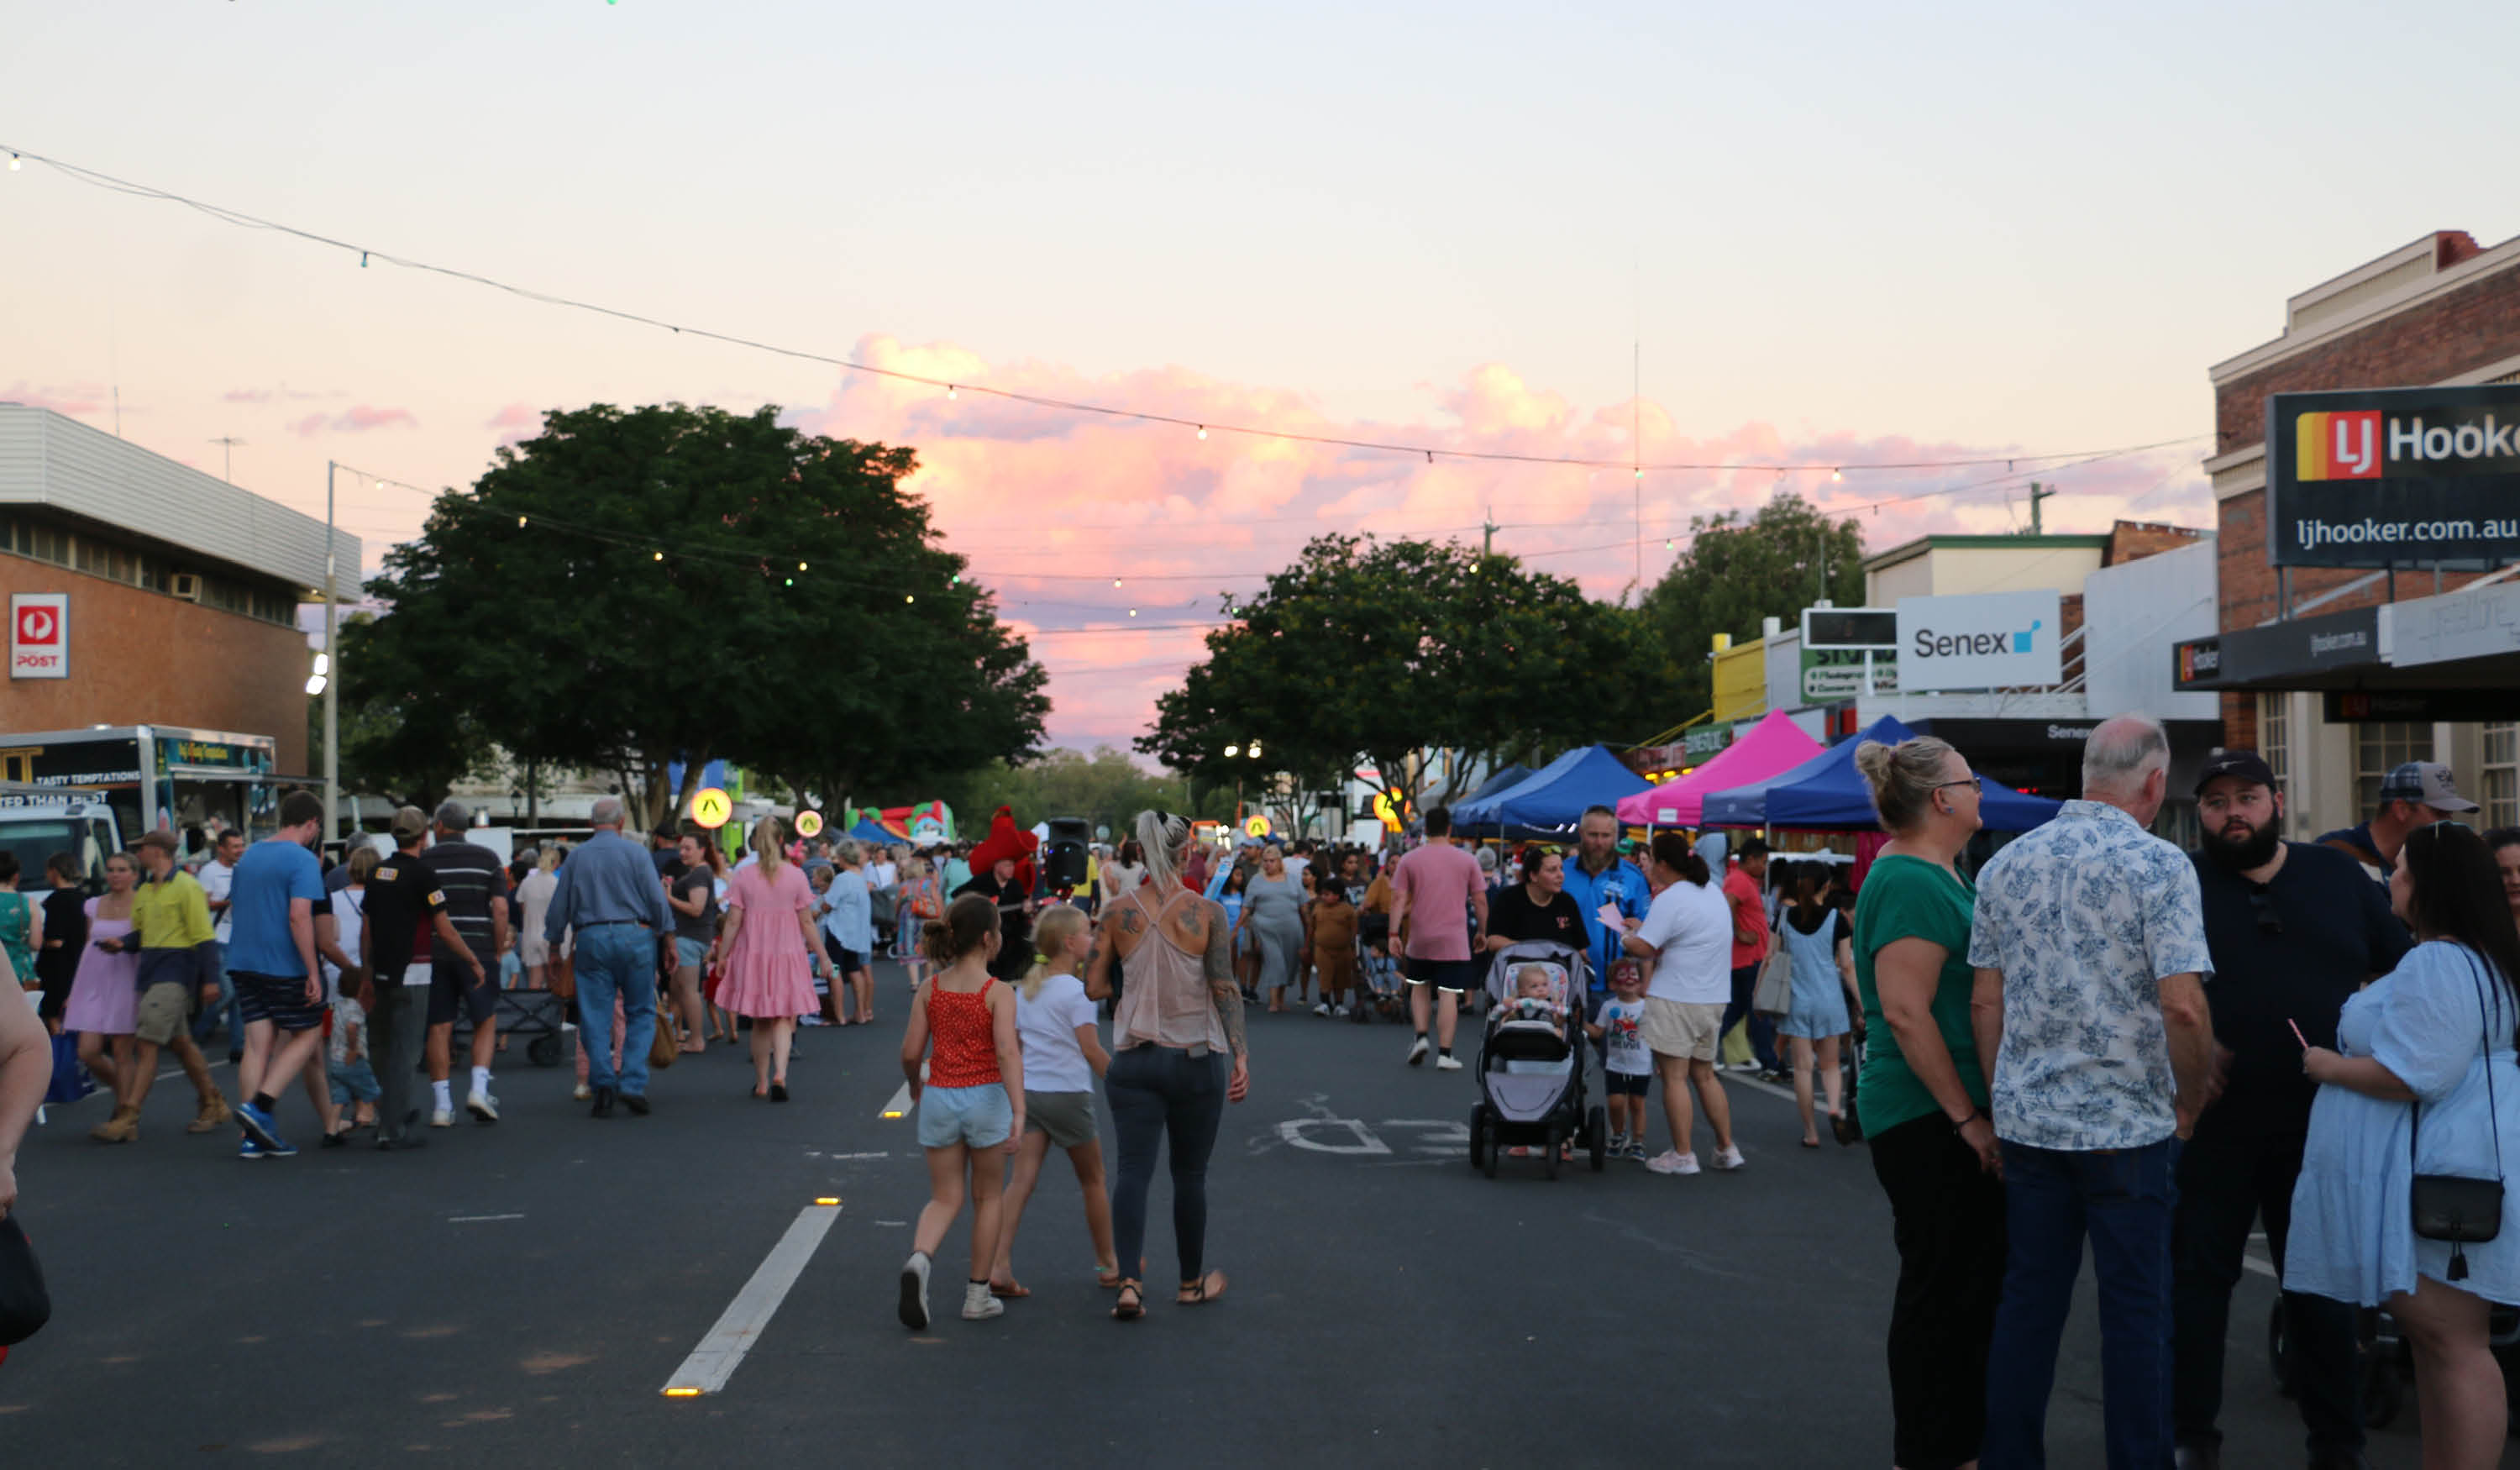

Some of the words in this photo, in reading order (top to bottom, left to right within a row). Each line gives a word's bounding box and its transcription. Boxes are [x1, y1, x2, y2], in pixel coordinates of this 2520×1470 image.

[2335, 418, 2372, 475] LJ
[2297, 517, 2518, 550] ljhooker.com.au
[1915, 628, 2008, 658] Senex
[17, 655, 59, 668] POST
[36, 775, 69, 787] TASTY
[71, 770, 141, 785] TEMPTATIONS
